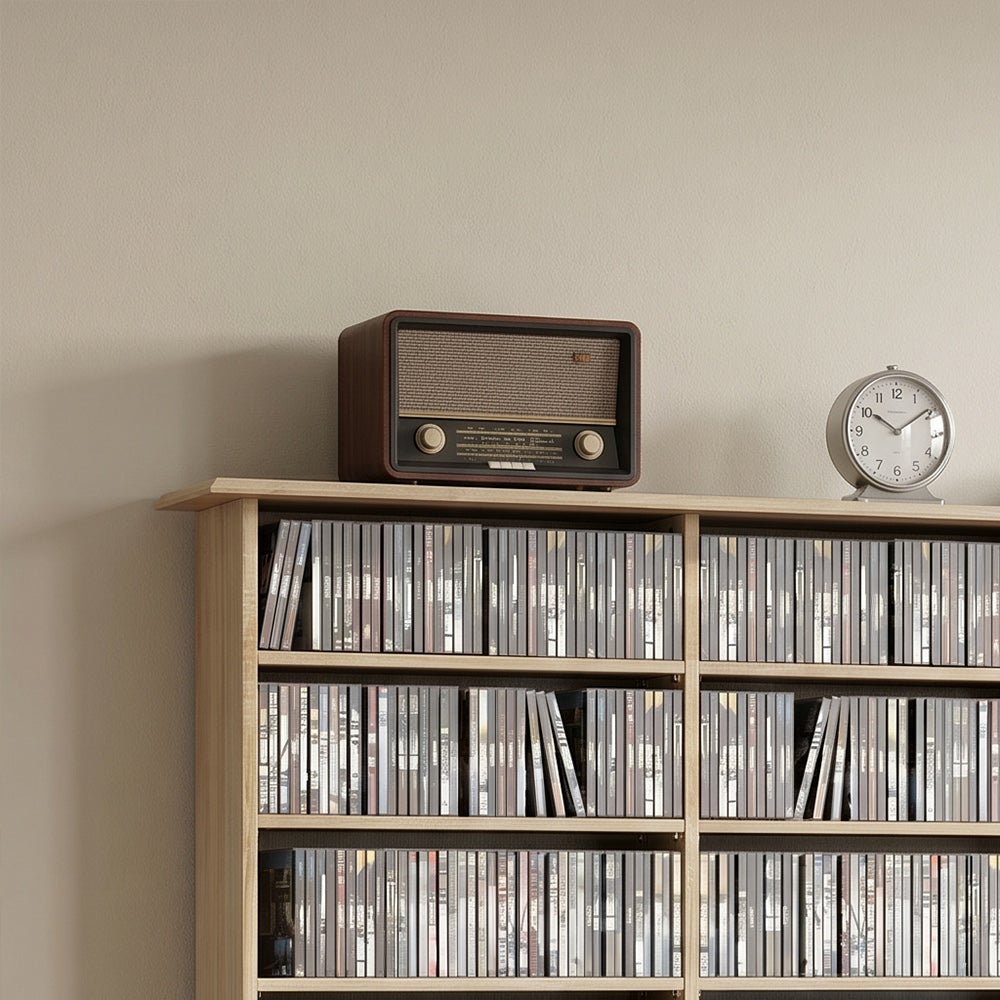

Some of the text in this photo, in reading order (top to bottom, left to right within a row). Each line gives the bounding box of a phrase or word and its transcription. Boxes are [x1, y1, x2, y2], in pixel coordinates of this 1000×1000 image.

[875, 393, 883, 403] 11
[891, 388, 903, 399] 12
[861, 407, 872, 418] 10
[855, 426, 863, 437] 9
[861, 445, 869, 457] 8
[925, 447, 932, 458] 4
[875, 460, 883, 470] 7
[893, 465, 902, 476] 6
[912, 461, 920, 472] 5
